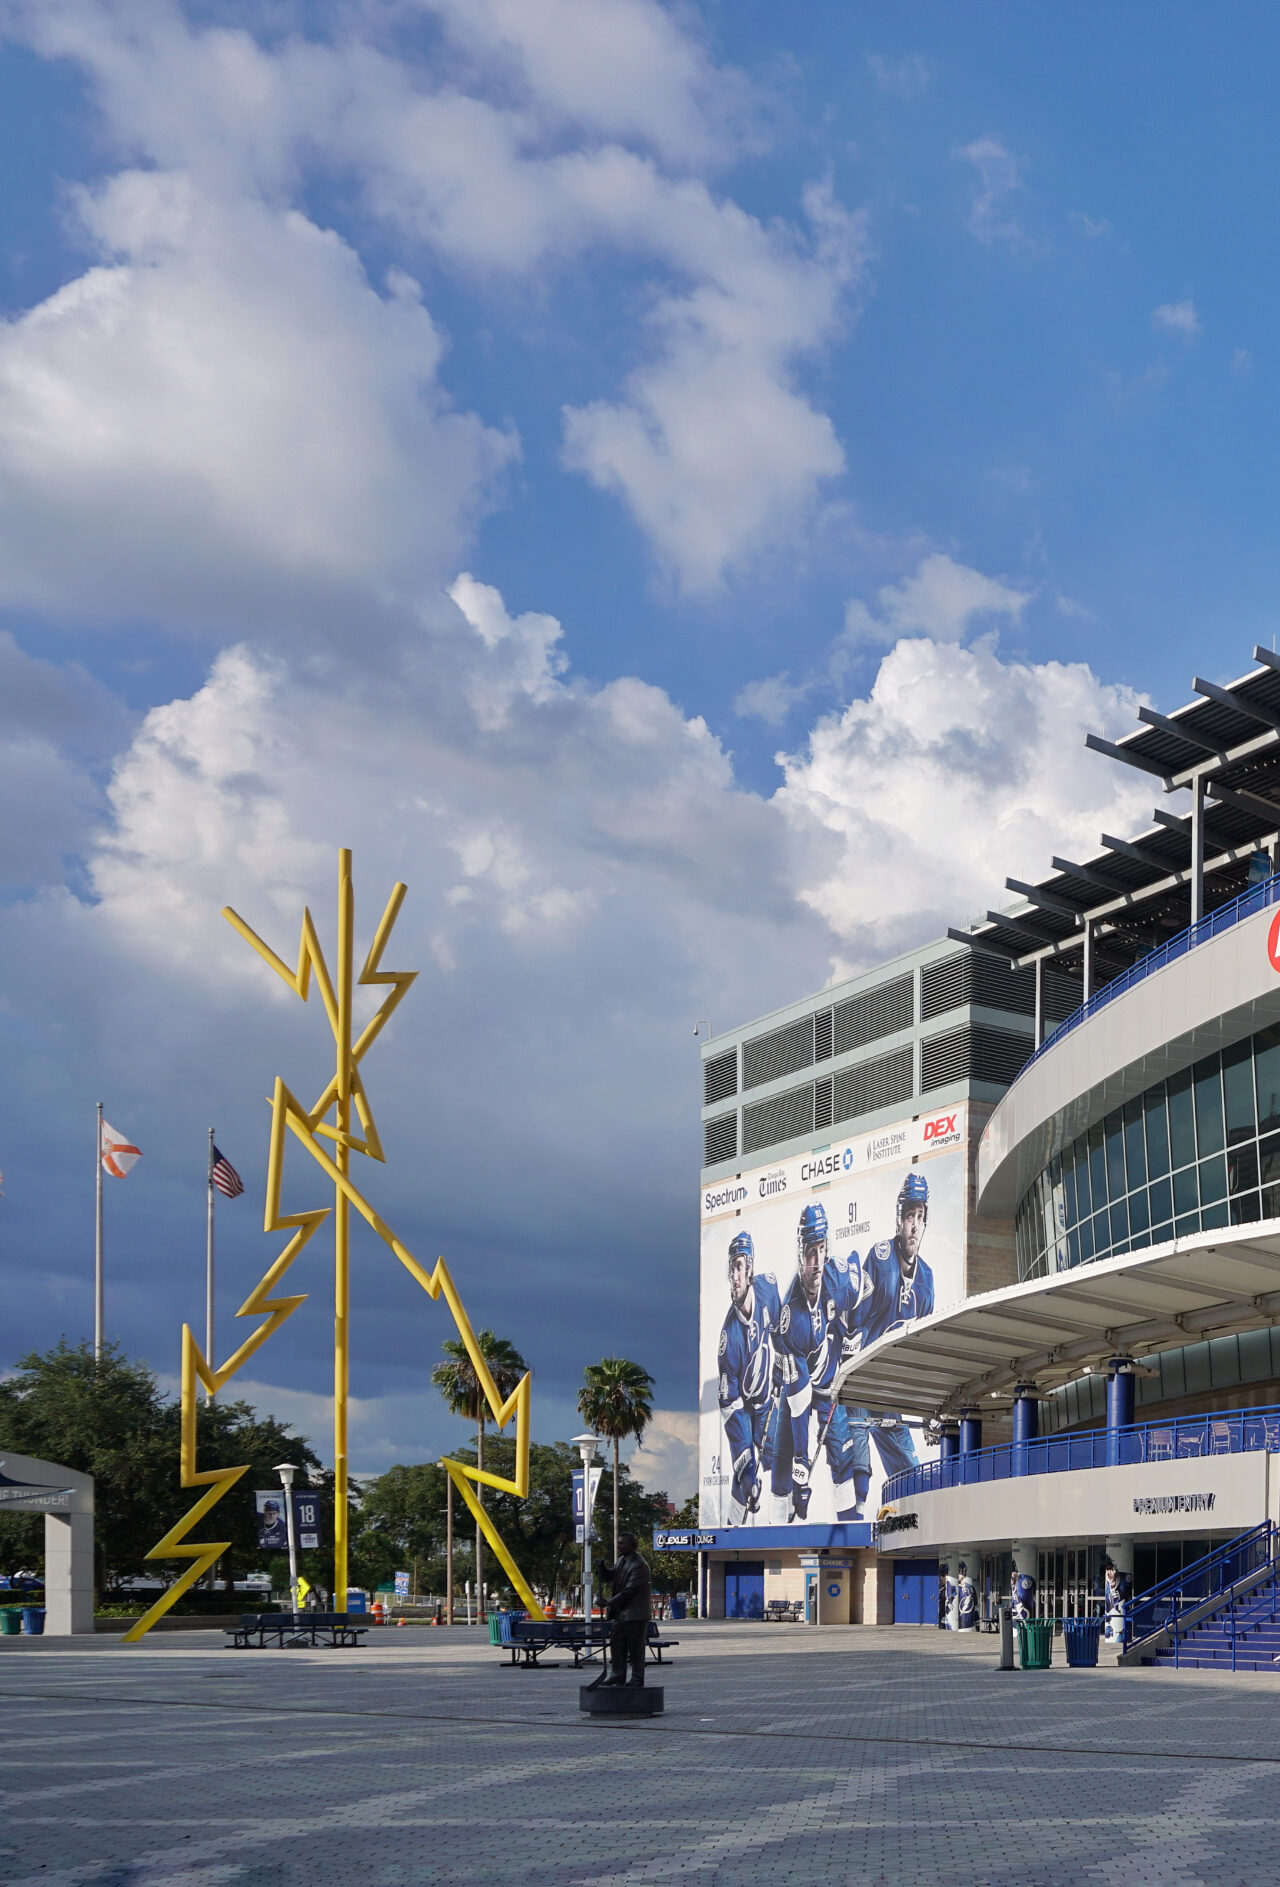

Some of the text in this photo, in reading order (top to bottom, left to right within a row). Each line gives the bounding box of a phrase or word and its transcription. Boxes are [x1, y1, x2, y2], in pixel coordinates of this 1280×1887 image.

[923, 1113, 957, 1141] DEX
[873, 1131, 907, 1151] LASER SPINE
[930, 1132, 961, 1147] imaging
[873, 1144, 902, 1161] INSTITUTE
[801, 1153, 840, 1181] CHASE
[759, 1177, 787, 1198] Times
[705, 1186, 746, 1213] Spectrum
[848, 1201, 857, 1223] 91
[712, 1455, 720, 1474] 24
[299, 1504, 315, 1524] 18
[664, 1536, 688, 1545] LEXUS
